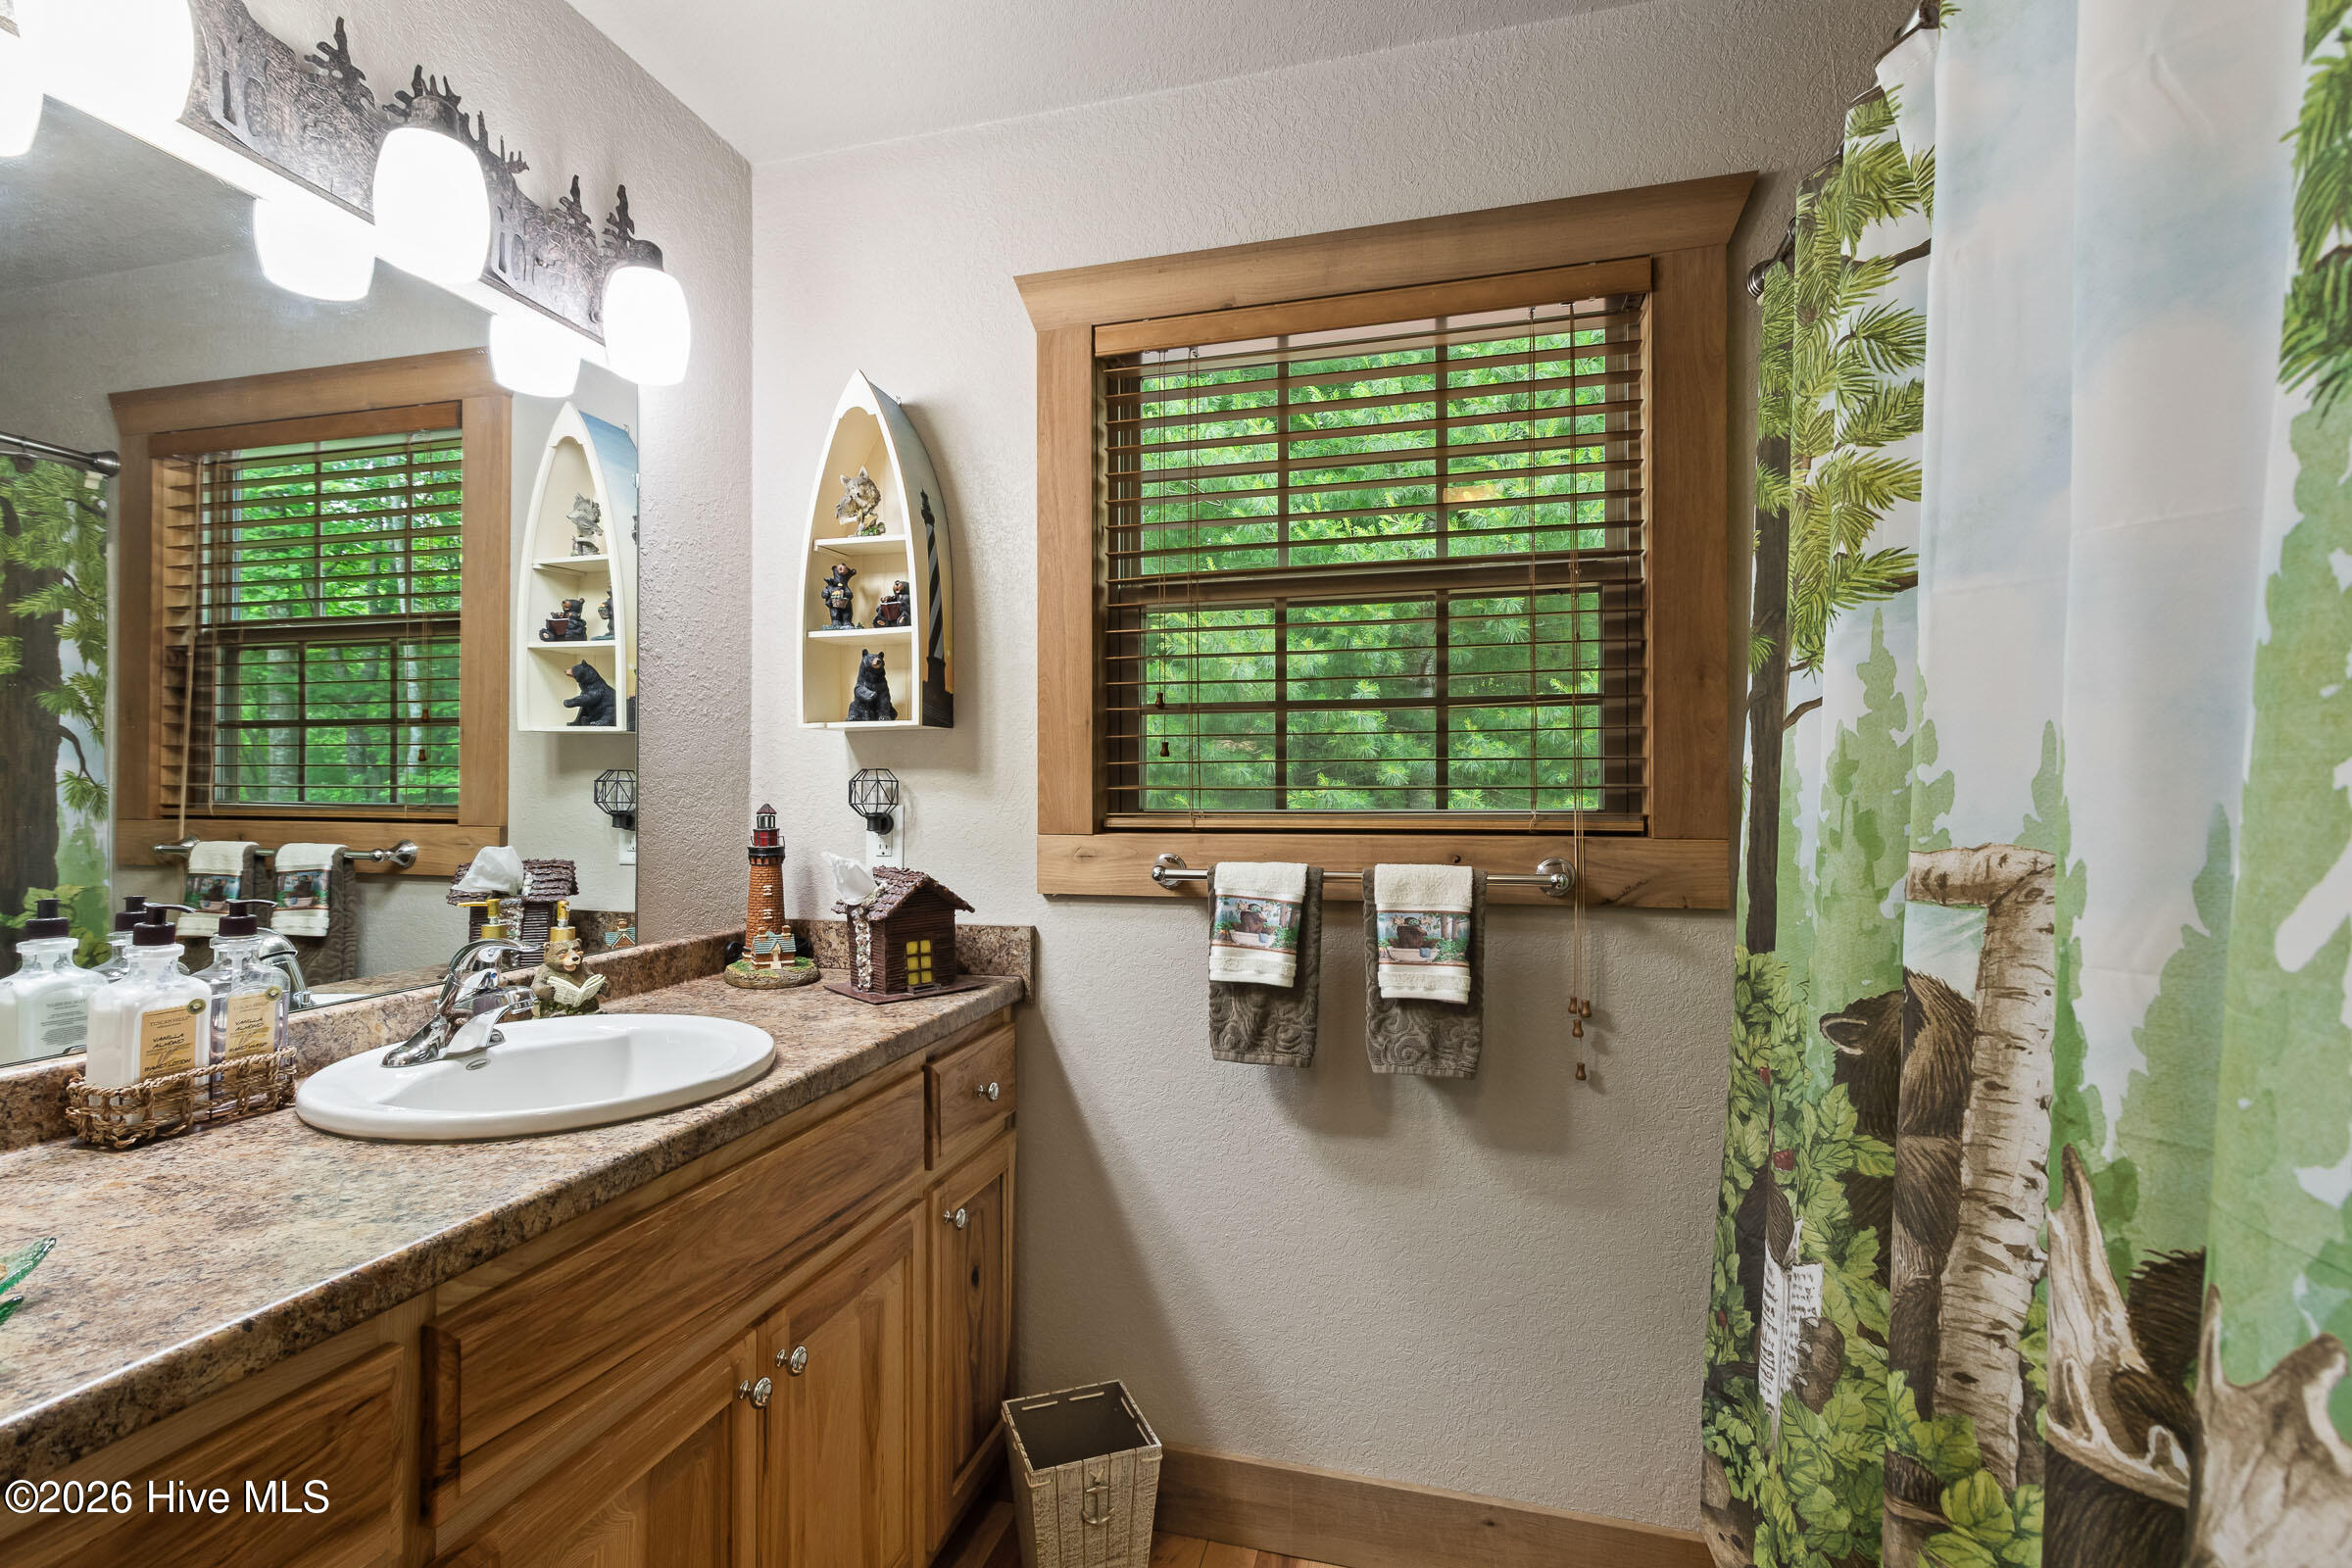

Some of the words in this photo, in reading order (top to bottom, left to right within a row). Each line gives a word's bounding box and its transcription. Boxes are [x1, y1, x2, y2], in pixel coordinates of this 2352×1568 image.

[235, 1022, 264, 1031] ALMOND
[153, 1033, 184, 1042] VANILLA
[153, 1039, 185, 1049] ALMOND
